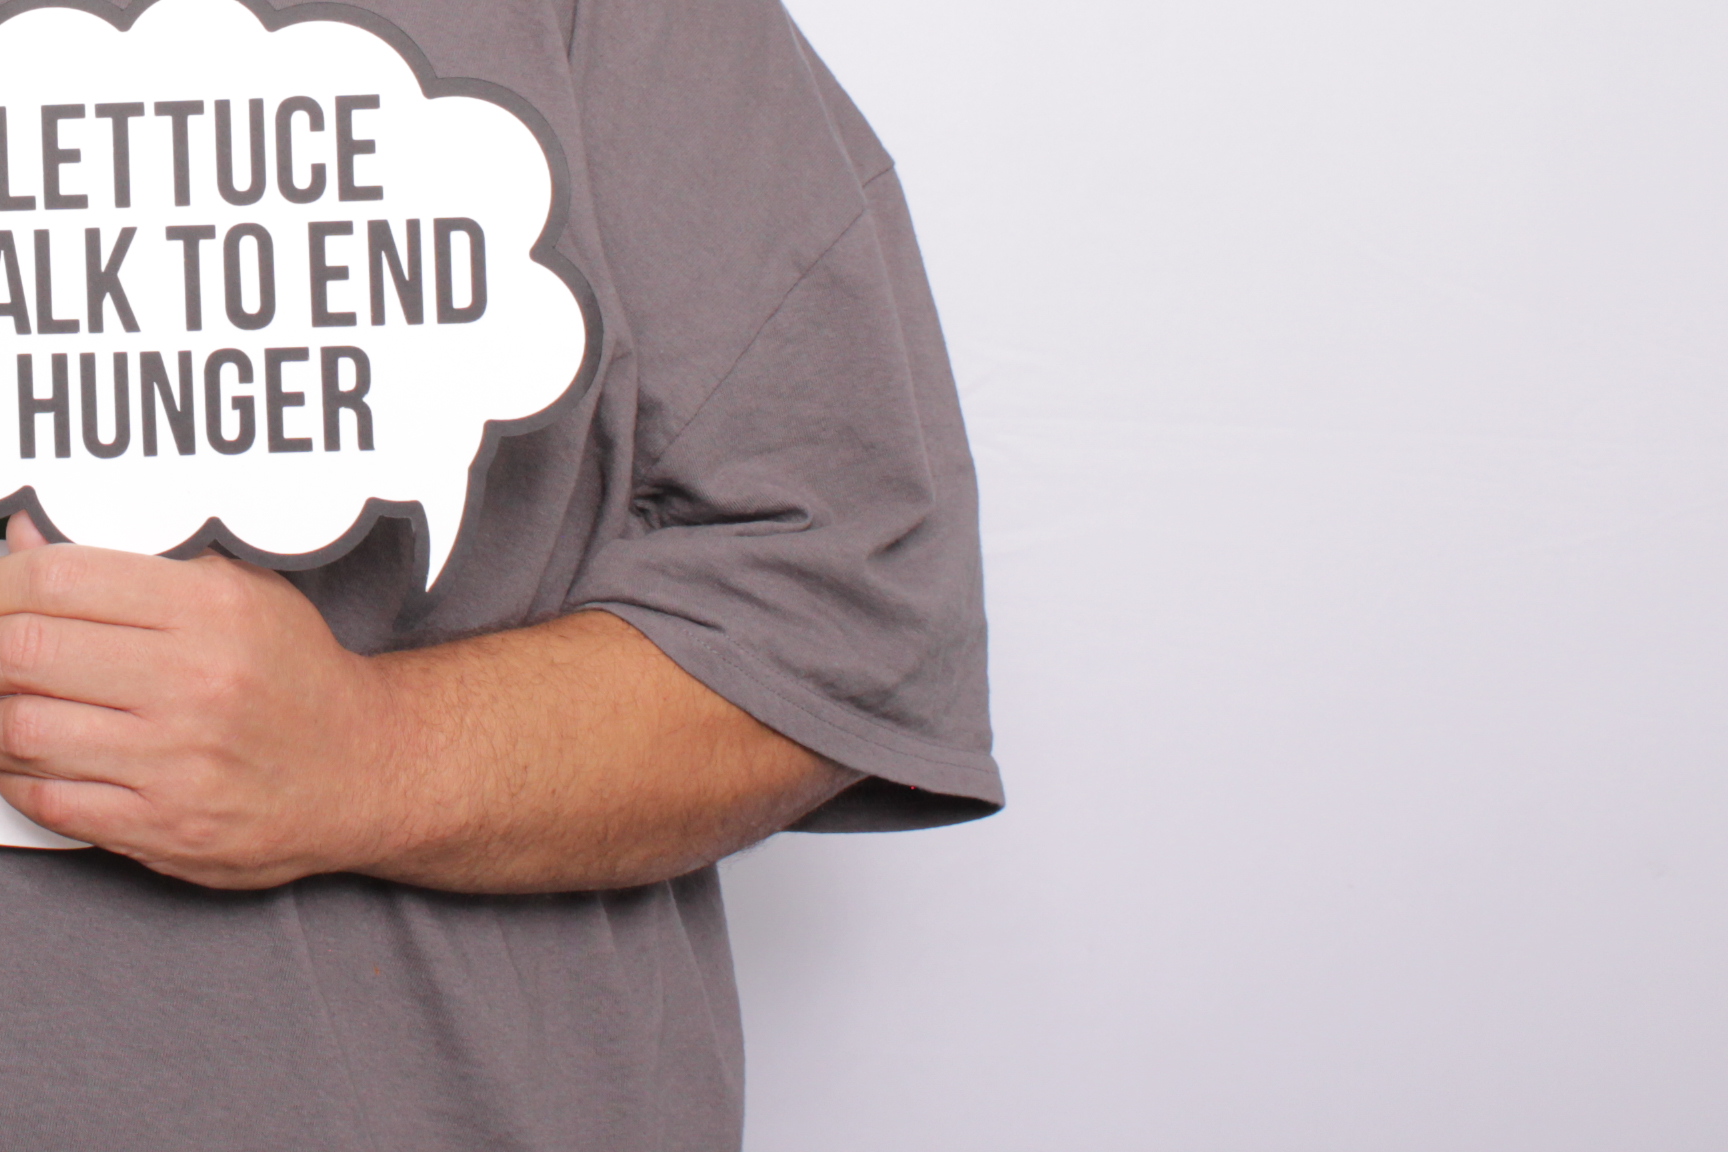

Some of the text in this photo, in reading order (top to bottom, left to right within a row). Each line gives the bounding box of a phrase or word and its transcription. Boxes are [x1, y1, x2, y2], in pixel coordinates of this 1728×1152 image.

[165, 222, 276, 332] TO
[306, 216, 488, 328] END
[15, 344, 376, 460] HUNGER
